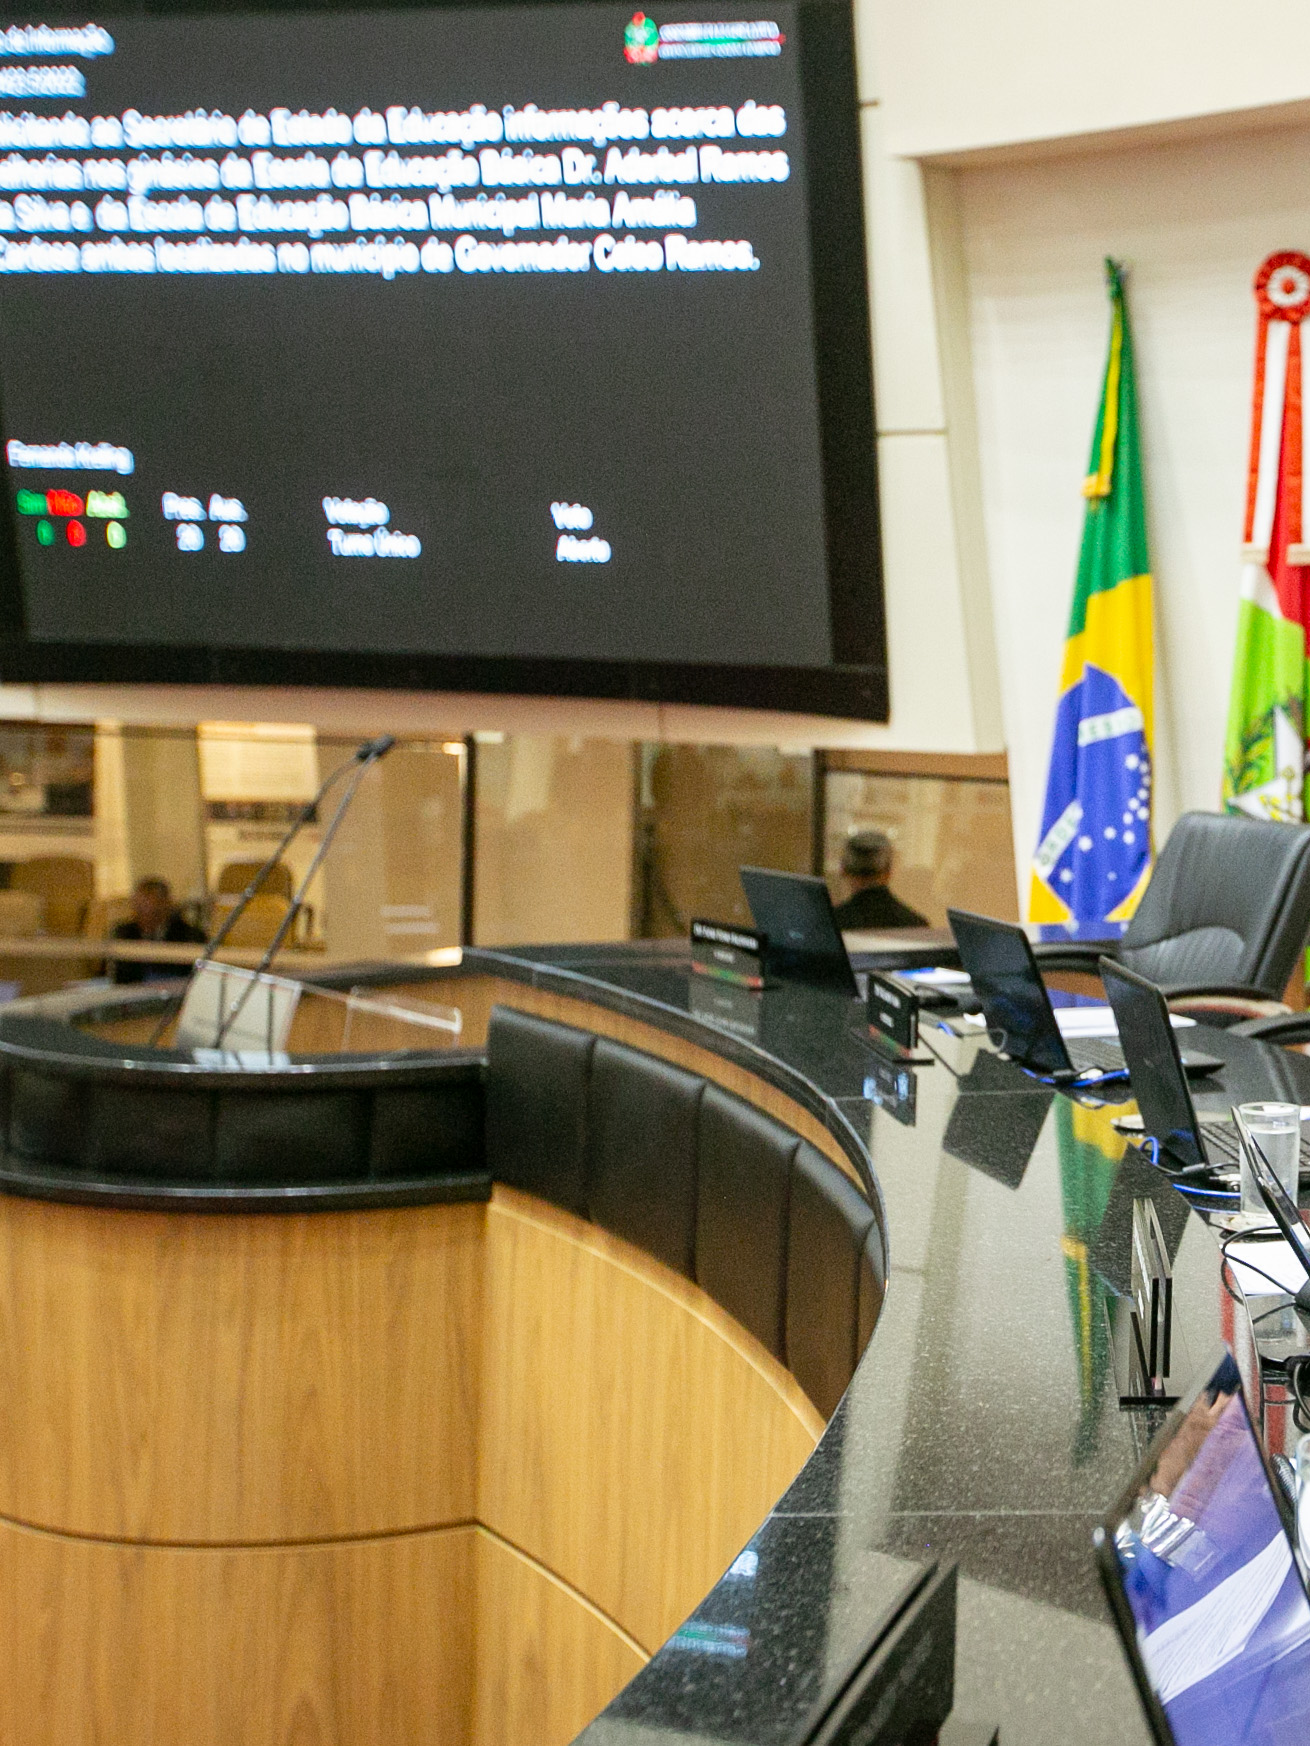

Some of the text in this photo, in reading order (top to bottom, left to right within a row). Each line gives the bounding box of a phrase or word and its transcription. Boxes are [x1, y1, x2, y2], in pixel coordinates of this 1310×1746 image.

[386, 104, 503, 150] Educação
[502, 102, 650, 148] informações
[363, 147, 480, 194] Educação
[561, 147, 603, 186] Dr.
[699, 144, 790, 184] Ramos
[236, 192, 350, 239] Educação
[428, 192, 541, 237] Municipal
[453, 234, 592, 273] Governador
[592, 233, 665, 273] Celso
